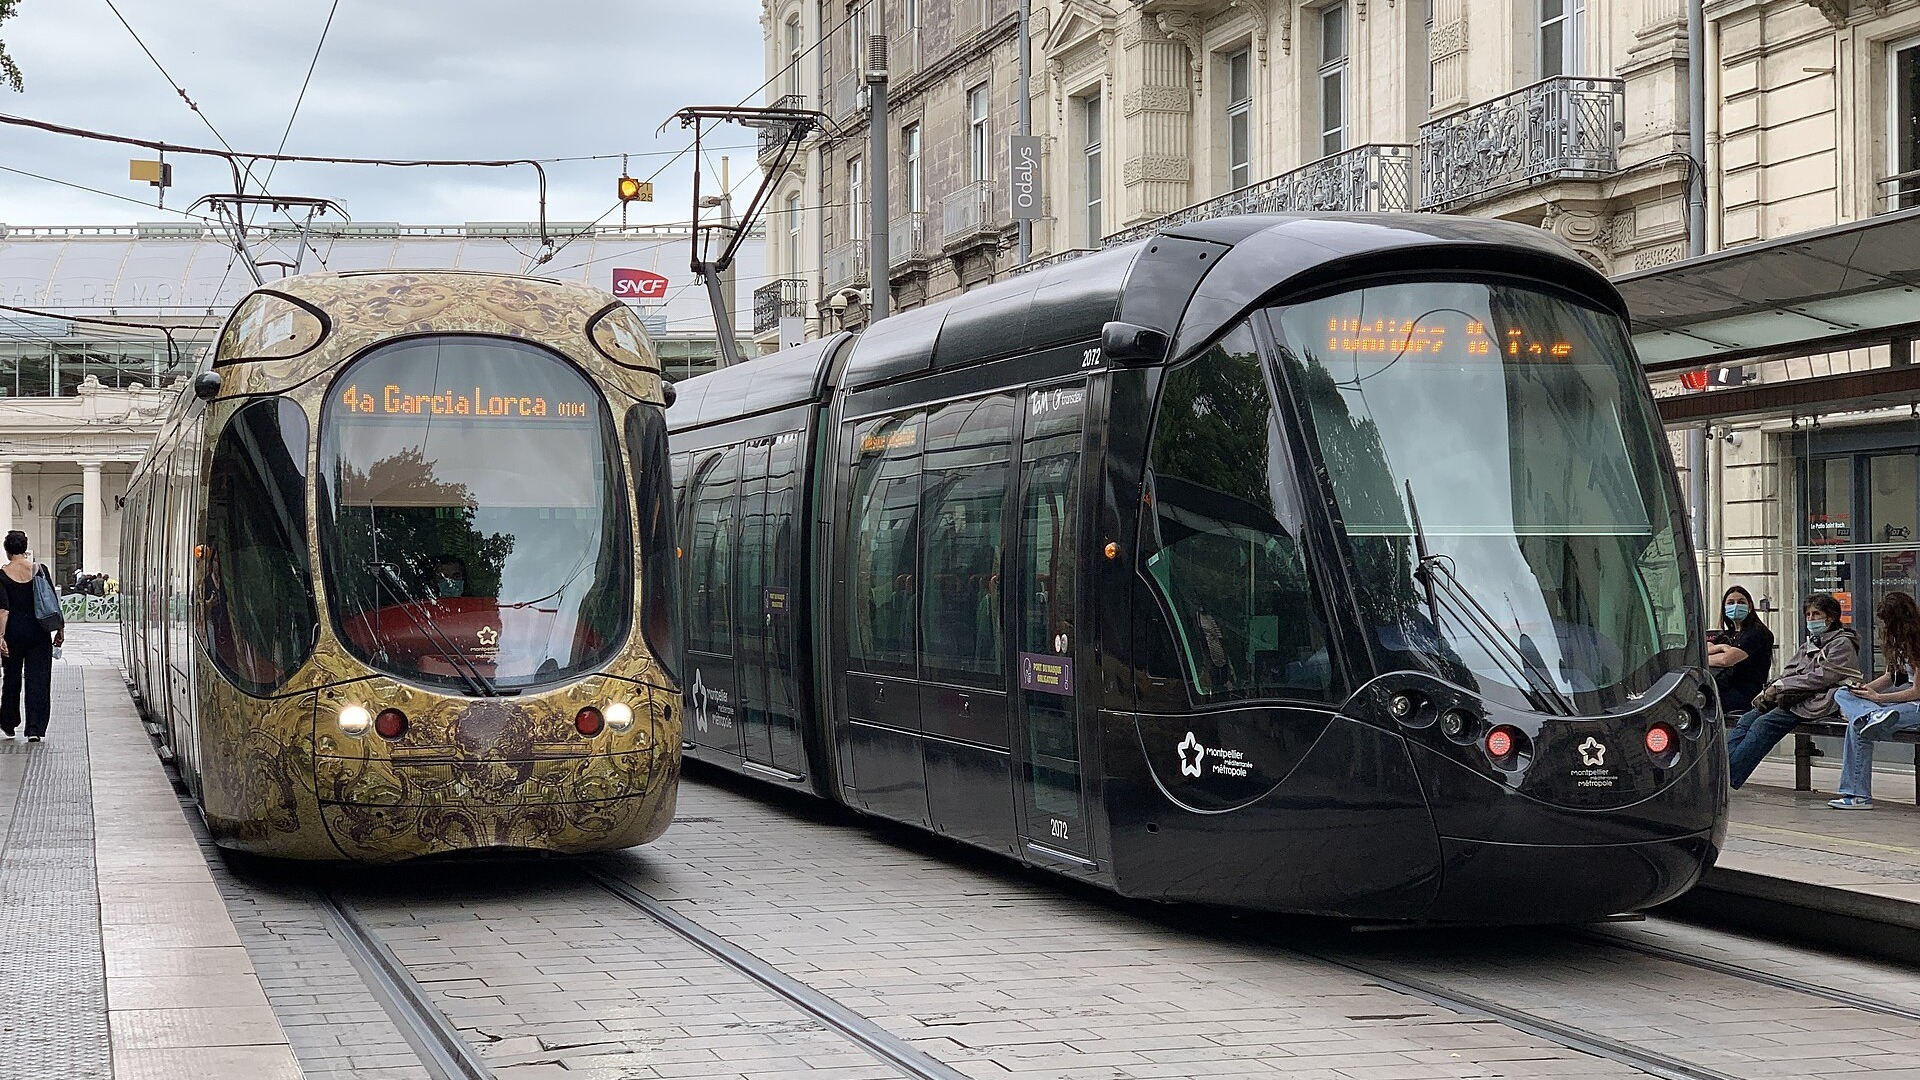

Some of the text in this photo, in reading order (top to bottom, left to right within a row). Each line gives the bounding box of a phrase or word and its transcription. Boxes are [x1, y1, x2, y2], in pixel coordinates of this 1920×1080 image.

[1014, 146, 1038, 208] Odalys
[614, 279, 665, 294] SNCF
[1081, 347, 1101, 368] 2072
[343, 384, 586, 417] 4a Garcia Lorca 0104
[1050, 818, 1069, 840] 2072
